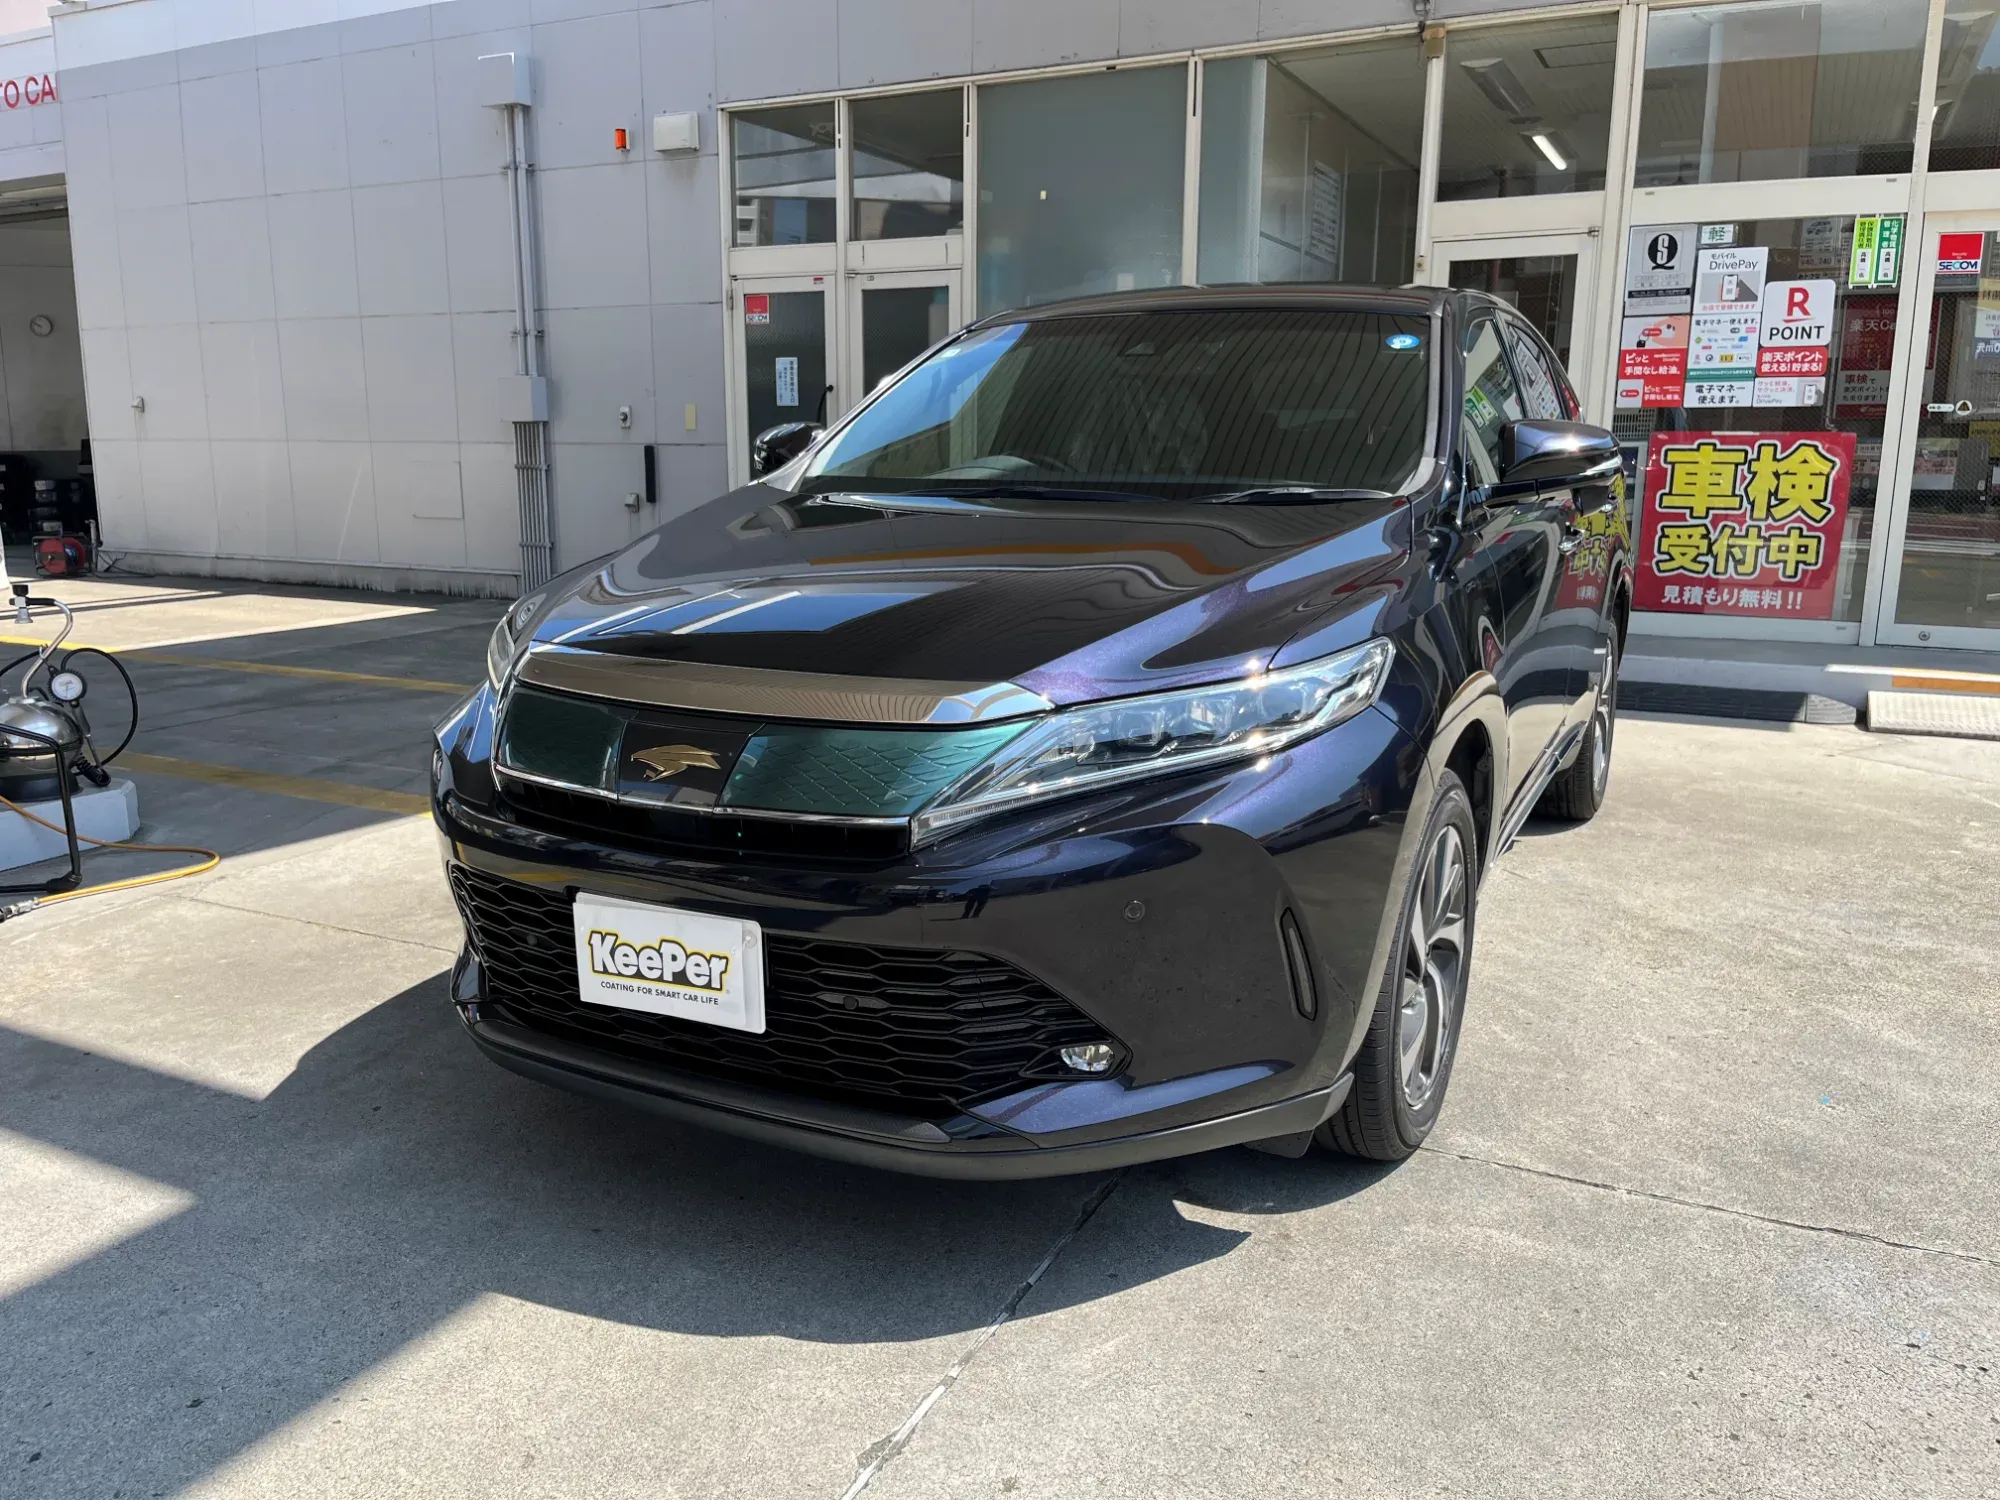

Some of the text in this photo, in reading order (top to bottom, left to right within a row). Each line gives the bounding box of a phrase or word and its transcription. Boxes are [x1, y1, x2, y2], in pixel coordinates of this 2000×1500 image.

[0, 80, 20, 109] O
[1711, 252, 1737, 260] モバイル
[1709, 260, 1759, 270] DrivePay
[1938, 261, 1978, 270] SECOM
[1786, 287, 1811, 317] R
[1768, 325, 1825, 341] POINT
[1625, 353, 1649, 363] ピッと
[1761, 351, 1823, 362] 楽天ポイント
[1695, 384, 1746, 393] 電子マネー
[1697, 395, 1740, 404] 使えます。
[1659, 442, 1839, 524] 車検
[1654, 524, 1822, 580] 受付中
[588, 929, 730, 992] KeePer
[600, 980, 719, 1006] COATING FOR SMART CAR LIFE
